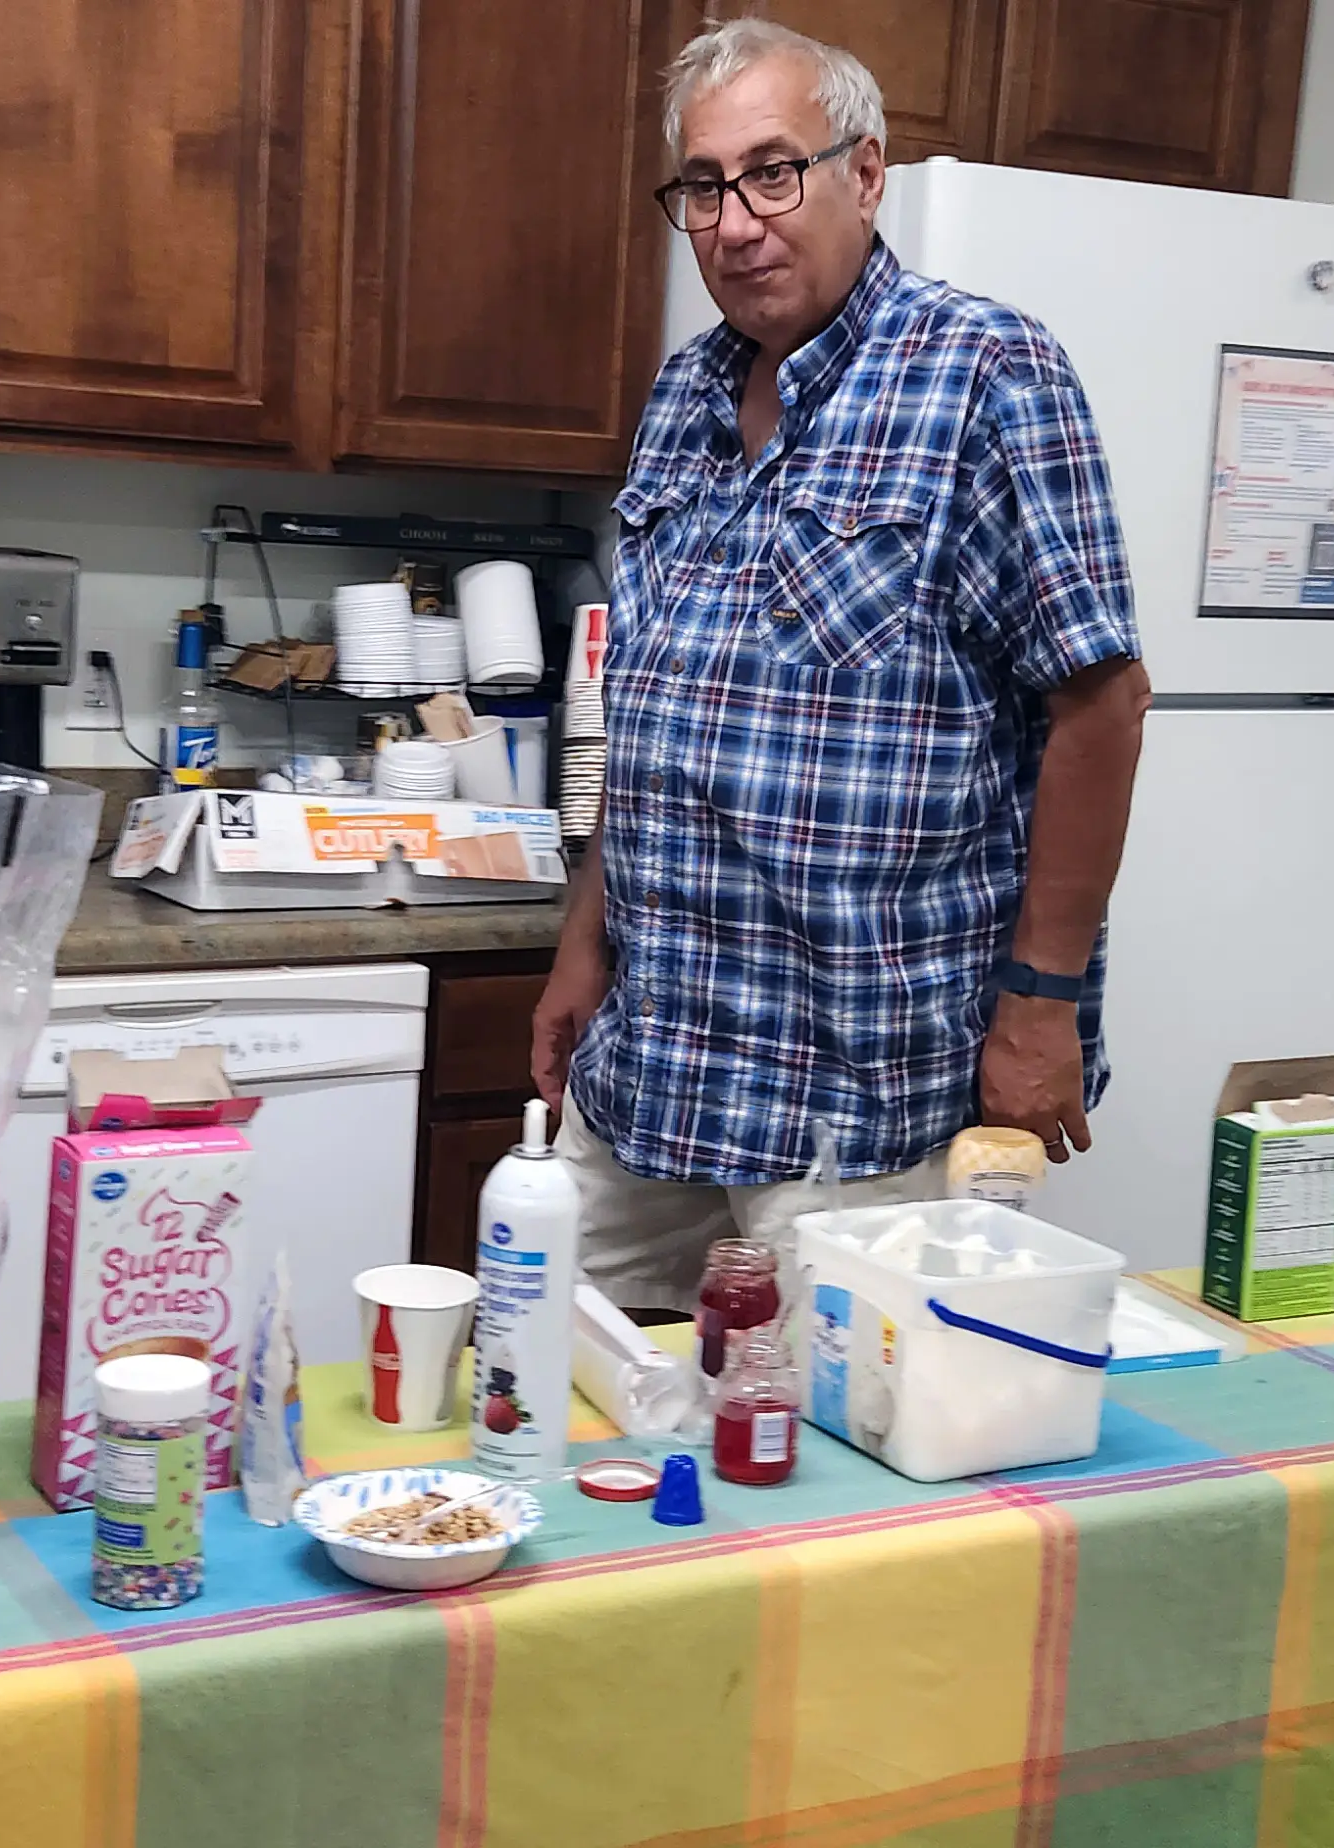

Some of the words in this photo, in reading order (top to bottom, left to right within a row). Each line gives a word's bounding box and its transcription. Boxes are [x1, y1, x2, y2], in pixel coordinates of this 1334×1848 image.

[152, 1210, 184, 1241] 12
[100, 1246, 226, 1288] Sugar
[102, 1287, 211, 1324] Cones
